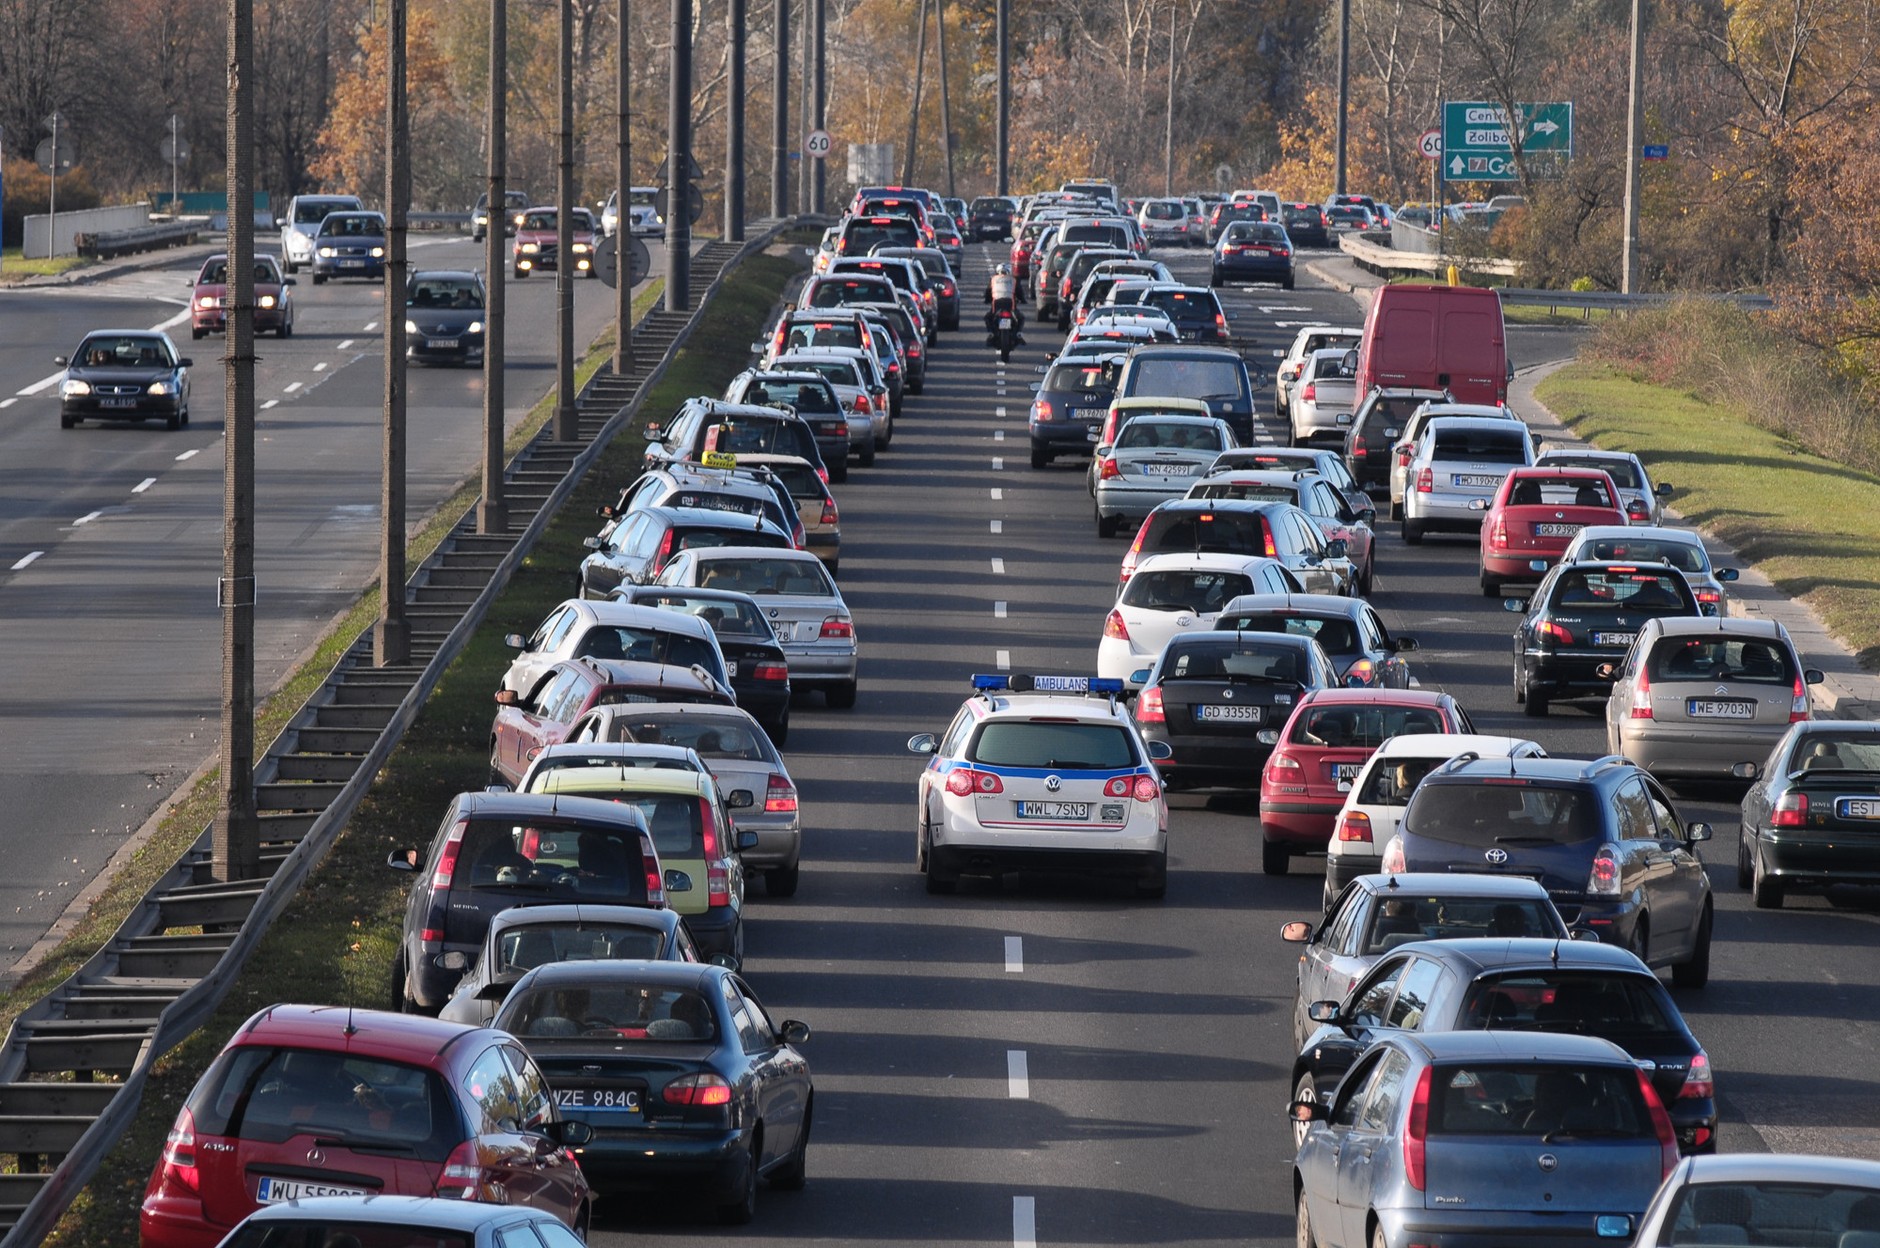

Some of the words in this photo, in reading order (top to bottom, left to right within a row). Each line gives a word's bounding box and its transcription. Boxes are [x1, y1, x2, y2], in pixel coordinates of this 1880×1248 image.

[809, 136, 829, 151] 60
[1474, 159, 1481, 170] 7
[1541, 525, 1553, 534] GD
[1556, 525, 1581, 535] 9390
[1035, 677, 1088, 690] AMBULANS
[1204, 706, 1220, 717] GD
[1224, 707, 1259, 719] 3355R
[1697, 703, 1713, 713] WE
[1719, 703, 1752, 715] 9703N
[1025, 802, 1051, 815] WWL
[1055, 803, 1086, 816] 7SN3
[593, 1090, 638, 1107] 984C
[272, 1181, 299, 1200] WU
